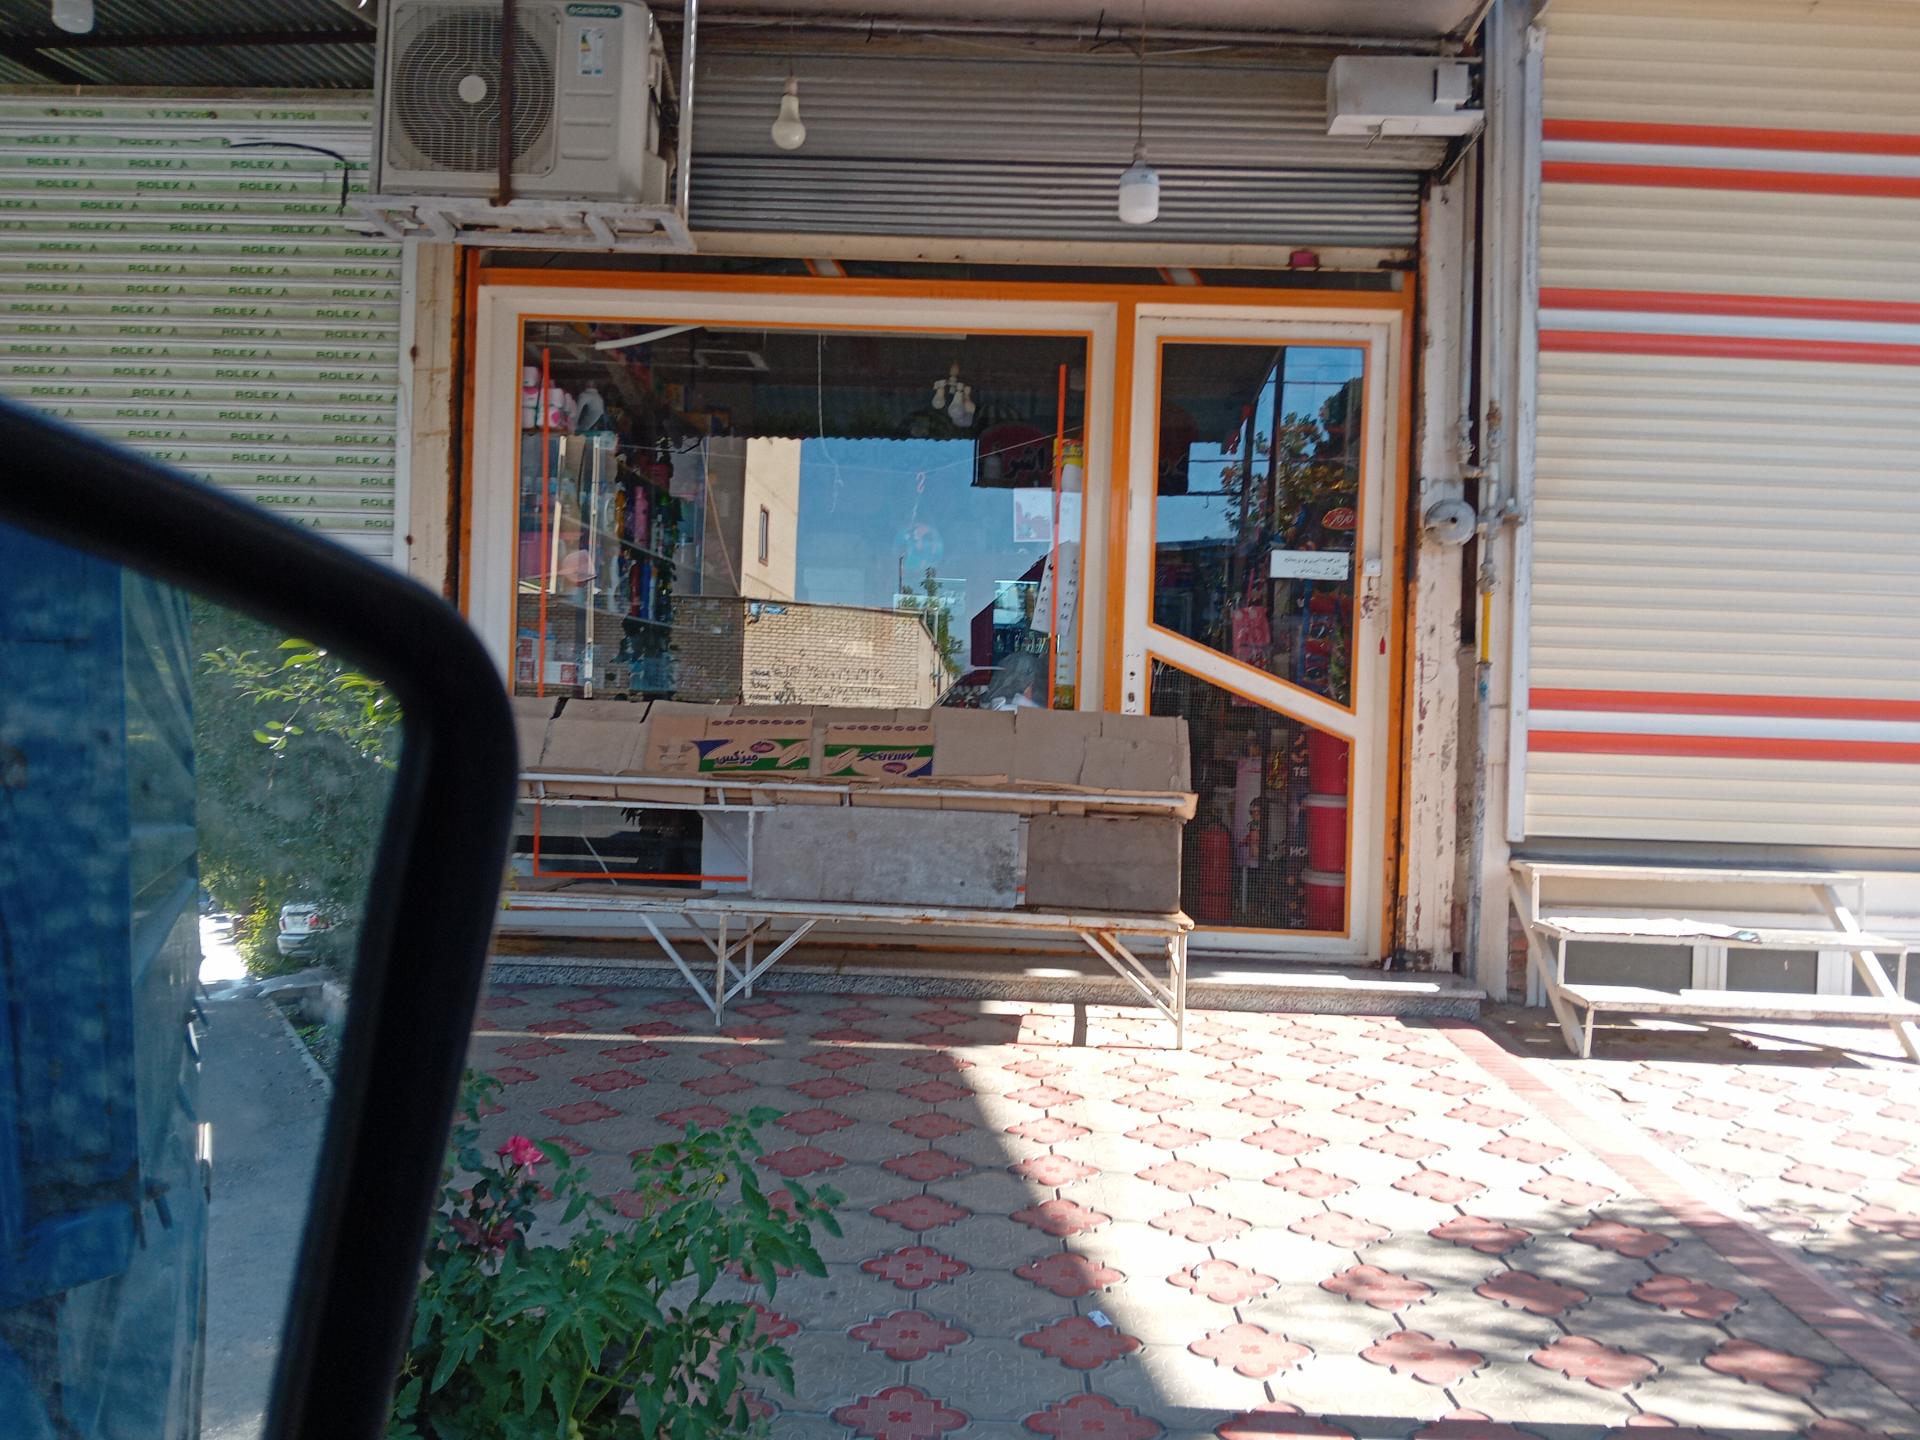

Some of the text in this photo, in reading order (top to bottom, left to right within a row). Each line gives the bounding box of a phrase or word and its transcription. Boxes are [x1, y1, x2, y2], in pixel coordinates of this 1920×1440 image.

[80, 201, 123, 209] ROLEX
[182, 203, 224, 211] ROLEX
[284, 204, 328, 212] ROLEX
[345, 248, 388, 256] ROLEX
[129, 265, 170, 273] ROLEX
[12, 366, 55, 374] ROLEX
[216, 370, 259, 378] ROLEX
[319, 372, 363, 380] ROLEX
[31, 387, 74, 395] ROLEX
[132, 388, 176, 397] ROLEX
[339, 394, 383, 402] ROLEX
[219, 411, 263, 420] ROLEX
[323, 414, 366, 422] ROLEX
[230, 433, 274, 441] ROLEX
[334, 435, 378, 444] ROLEX
[232, 454, 276, 462] ROLEX
[336, 456, 380, 465] ROLEX
[256, 475, 300, 483] ROLEX
[256, 496, 300, 504] ROLEX
